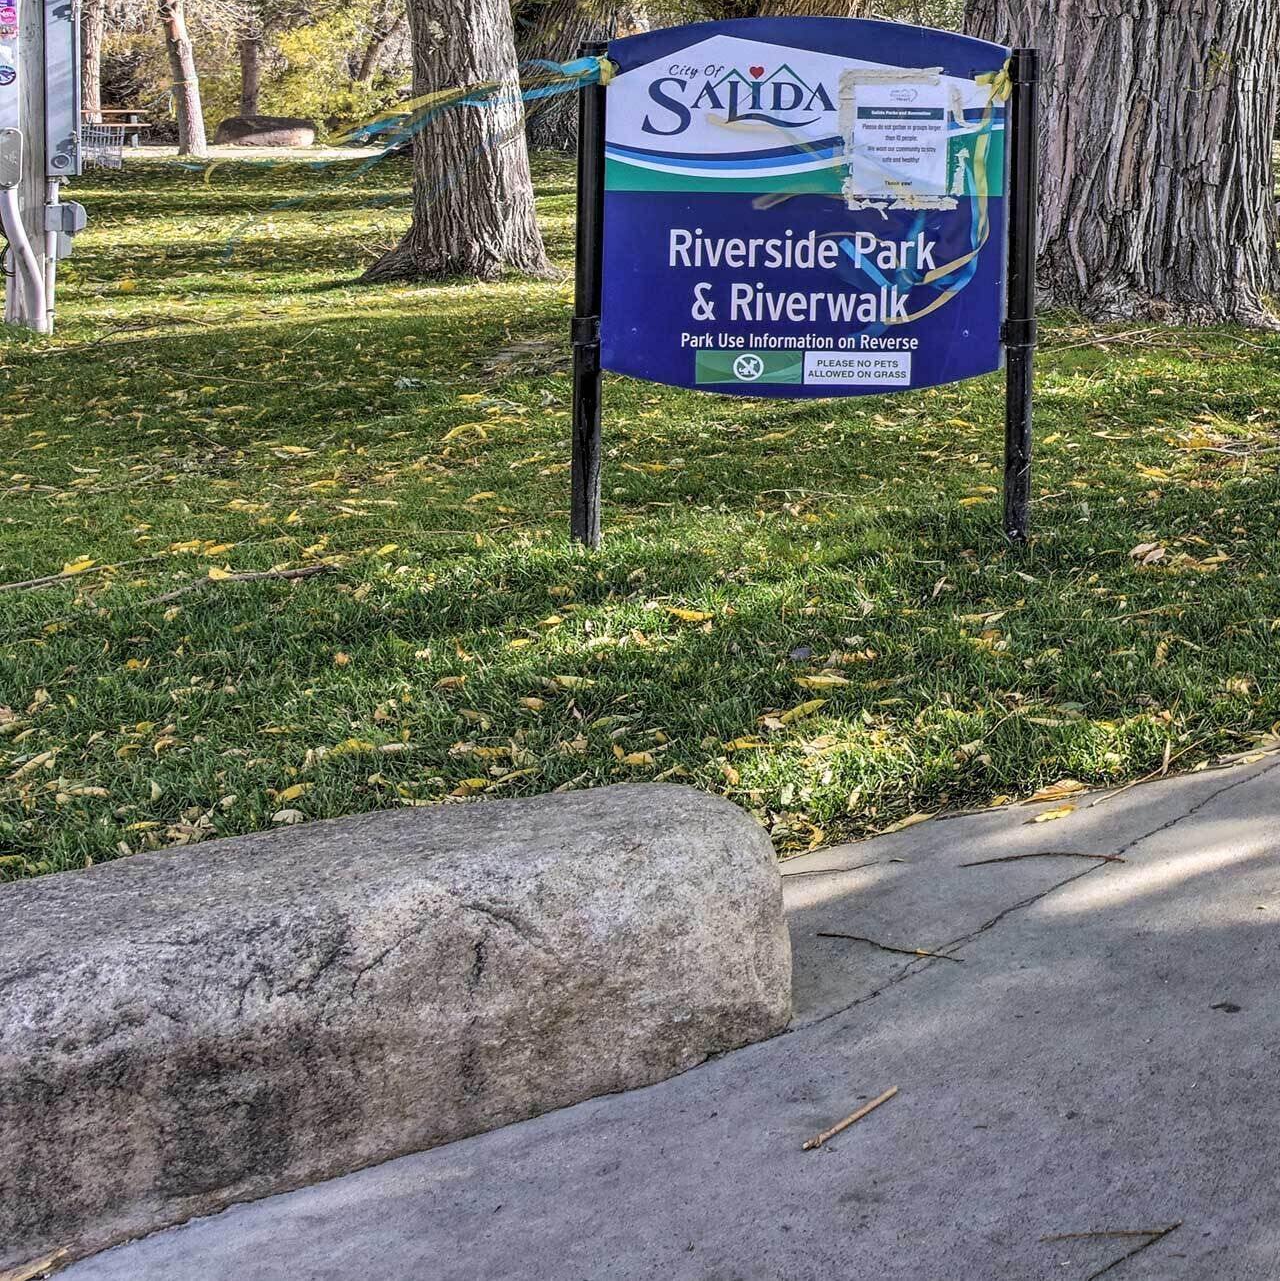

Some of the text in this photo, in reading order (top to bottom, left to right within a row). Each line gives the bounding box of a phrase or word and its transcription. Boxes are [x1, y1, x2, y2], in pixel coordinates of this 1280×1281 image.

[669, 64, 725, 79] City Of
[641, 77, 837, 136] SALIDA
[669, 228, 936, 270] Riverside Park
[691, 282, 910, 323] & Riverwalk
[681, 332, 919, 349] Park Use Information on Reverse
[817, 359, 898, 368] PLEASE NO PETS
[808, 370, 907, 379] ALLOWED ON GRASS
